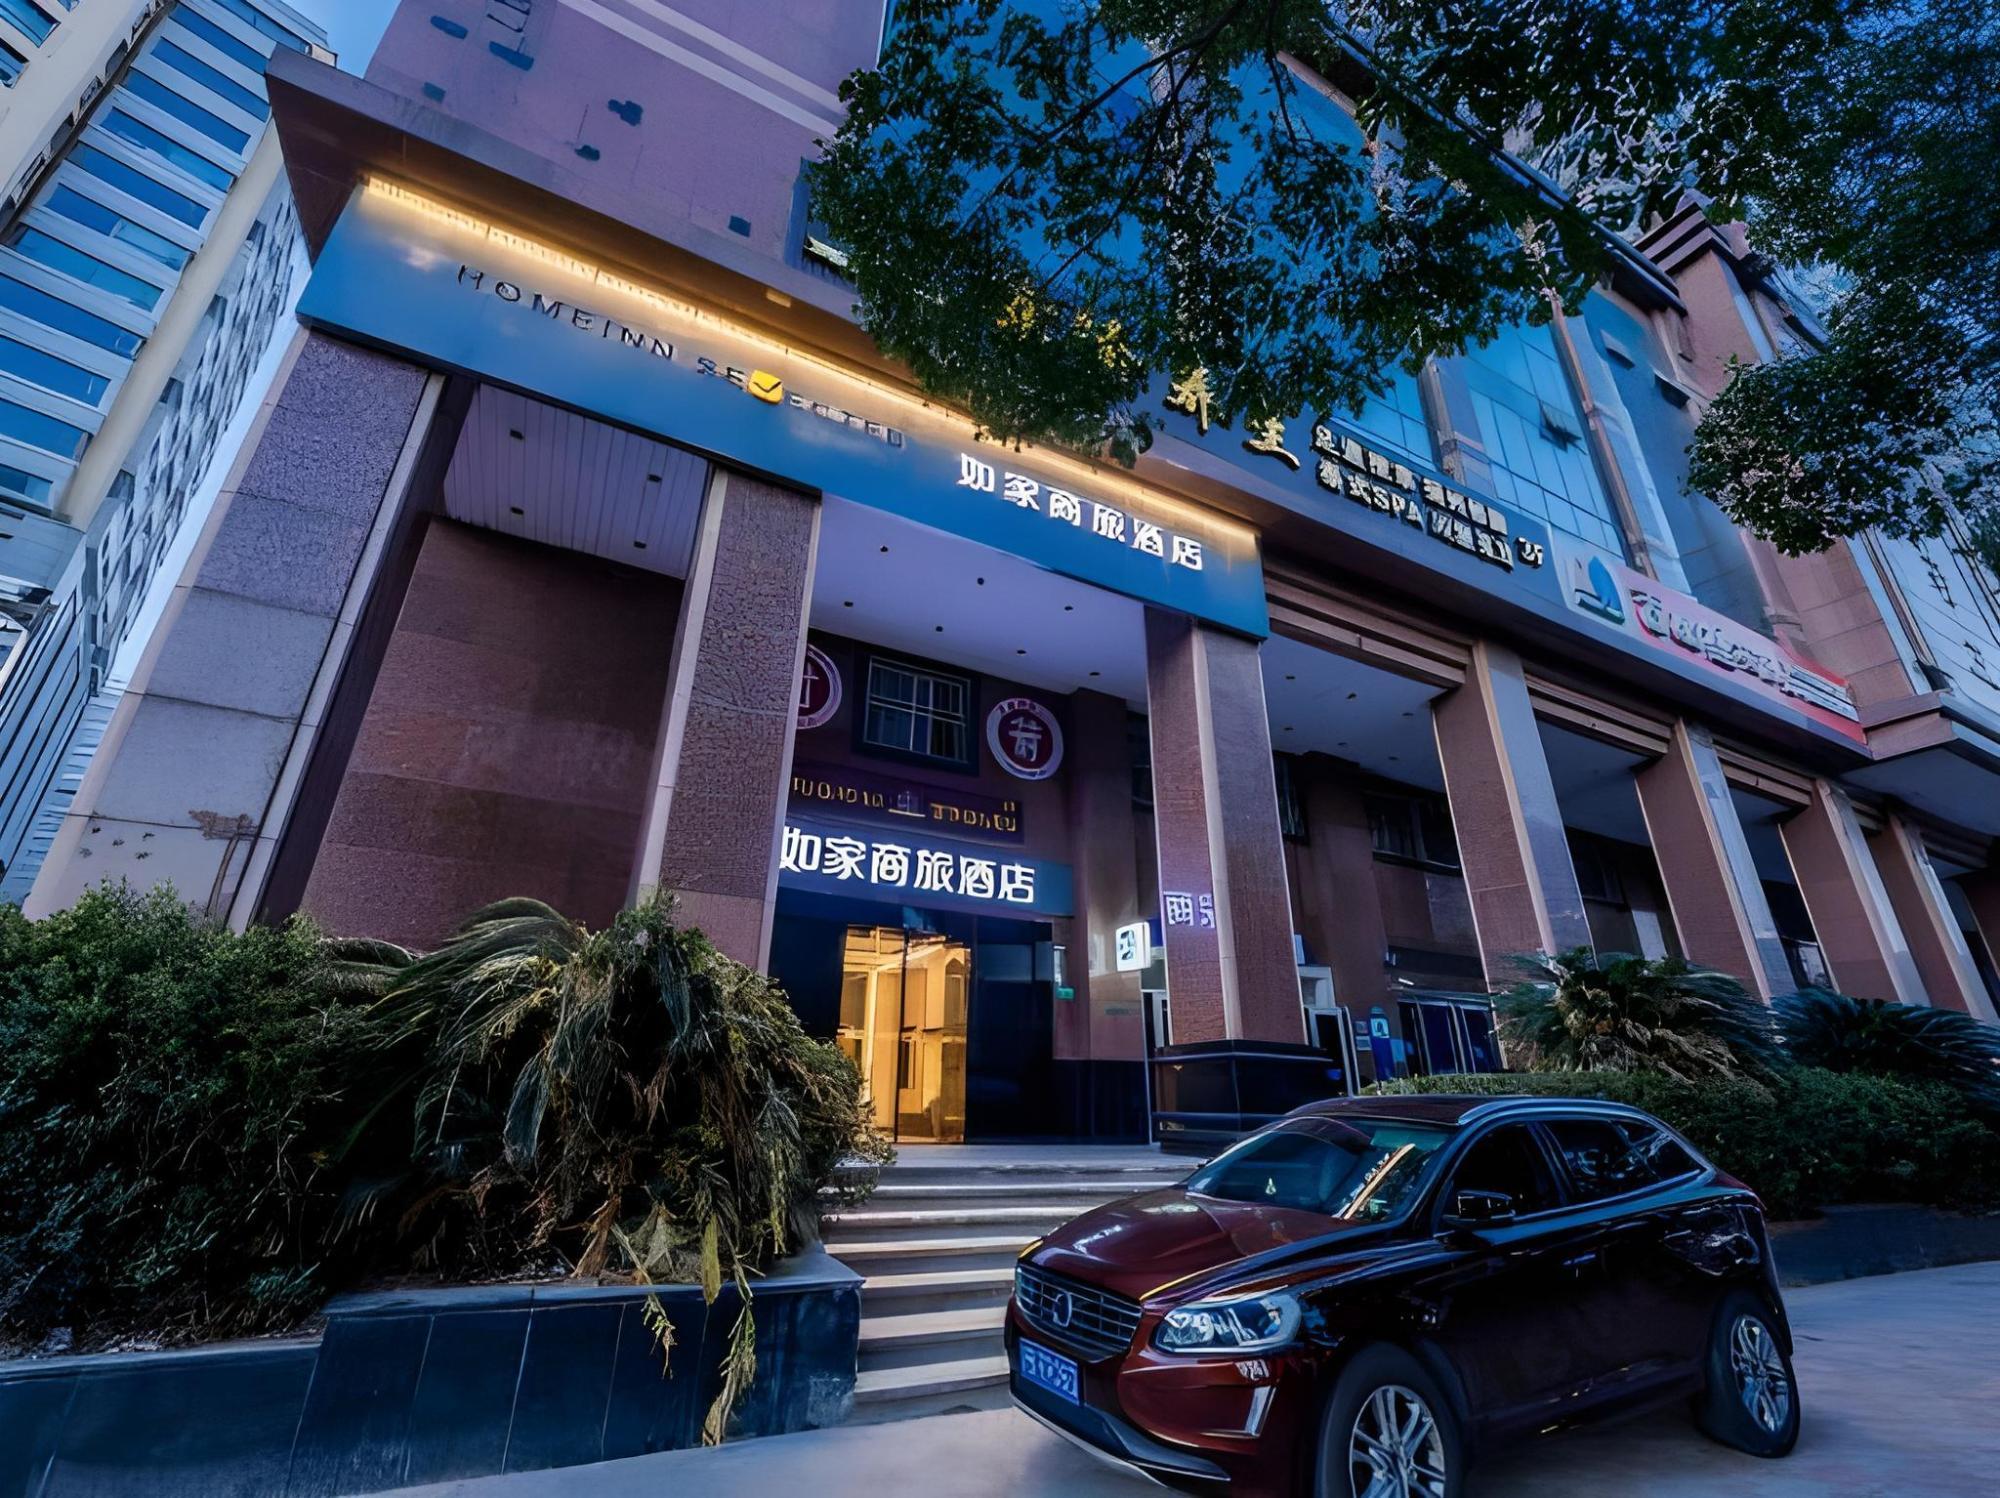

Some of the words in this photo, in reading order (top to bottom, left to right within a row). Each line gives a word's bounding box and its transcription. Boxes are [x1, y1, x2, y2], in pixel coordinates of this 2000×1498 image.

[956, 452, 1203, 571] 如家商旅酒店
[779, 825, 1035, 903] 如家商旅酒店
